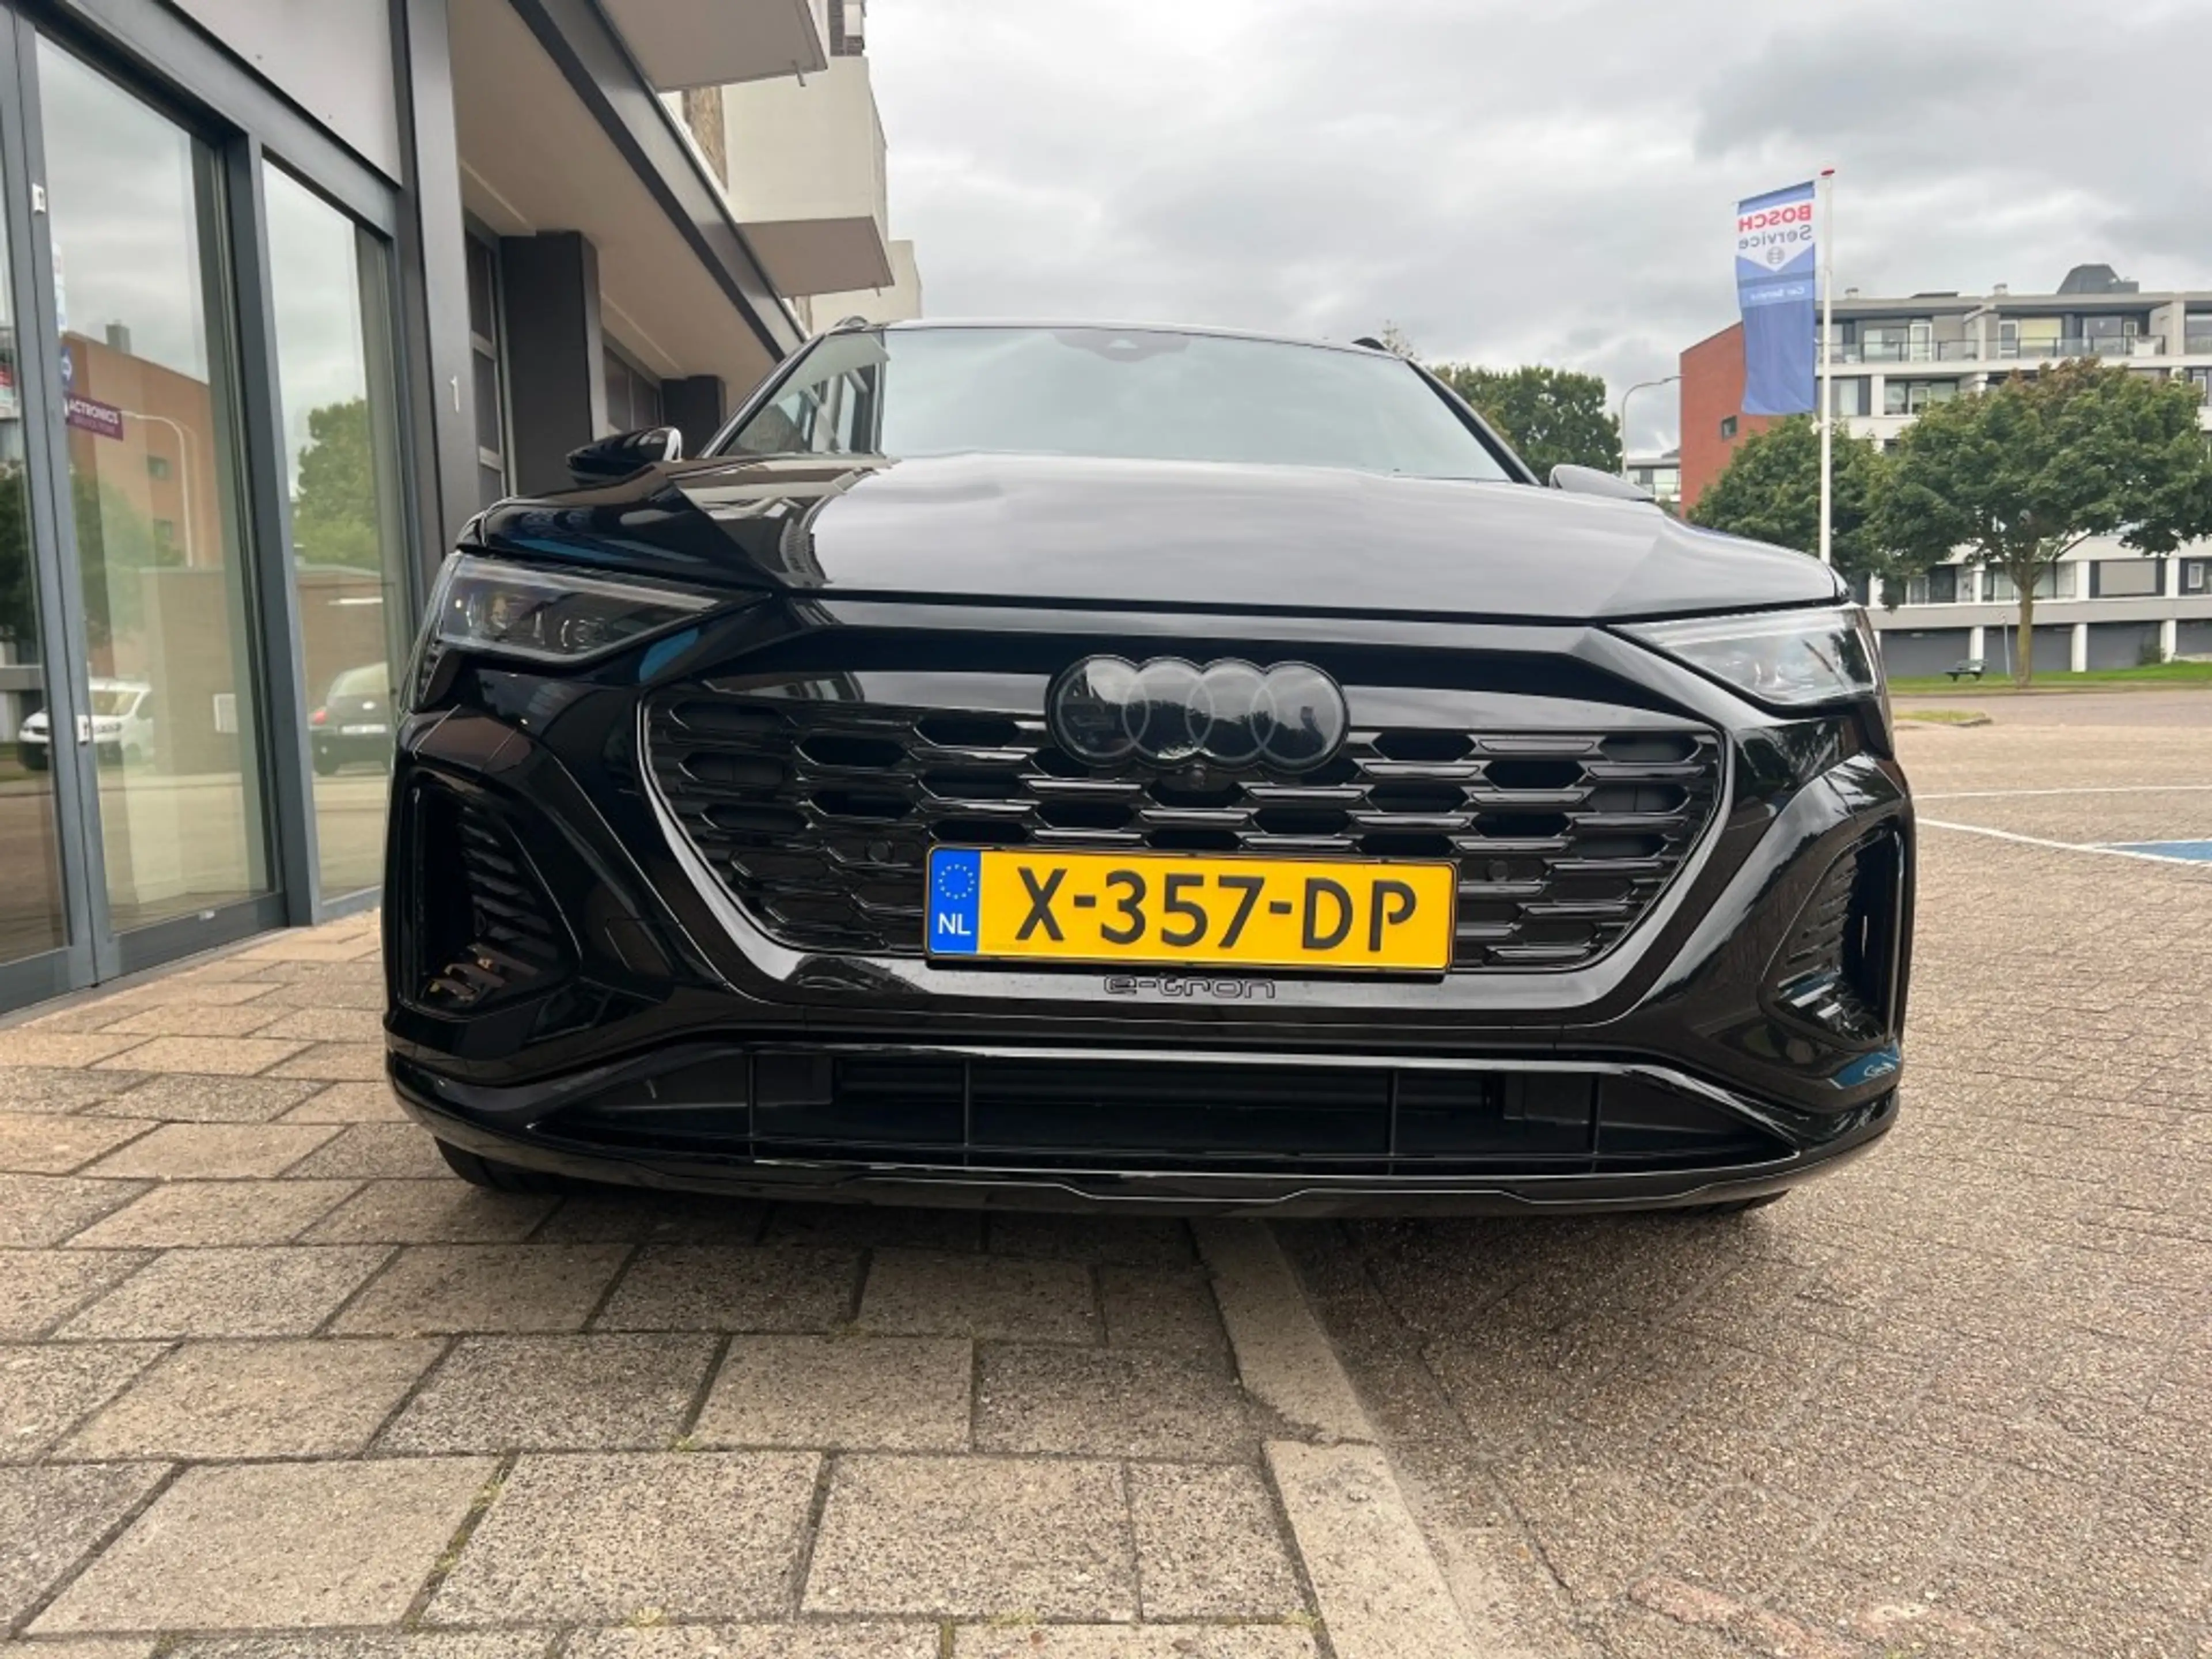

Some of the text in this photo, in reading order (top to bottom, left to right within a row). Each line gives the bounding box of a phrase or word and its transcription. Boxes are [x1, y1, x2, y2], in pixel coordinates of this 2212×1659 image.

[1016, 866, 1417, 952] X-357-DP
[938, 913, 971, 935] NL
[1104, 972, 1275, 999] e-tron
